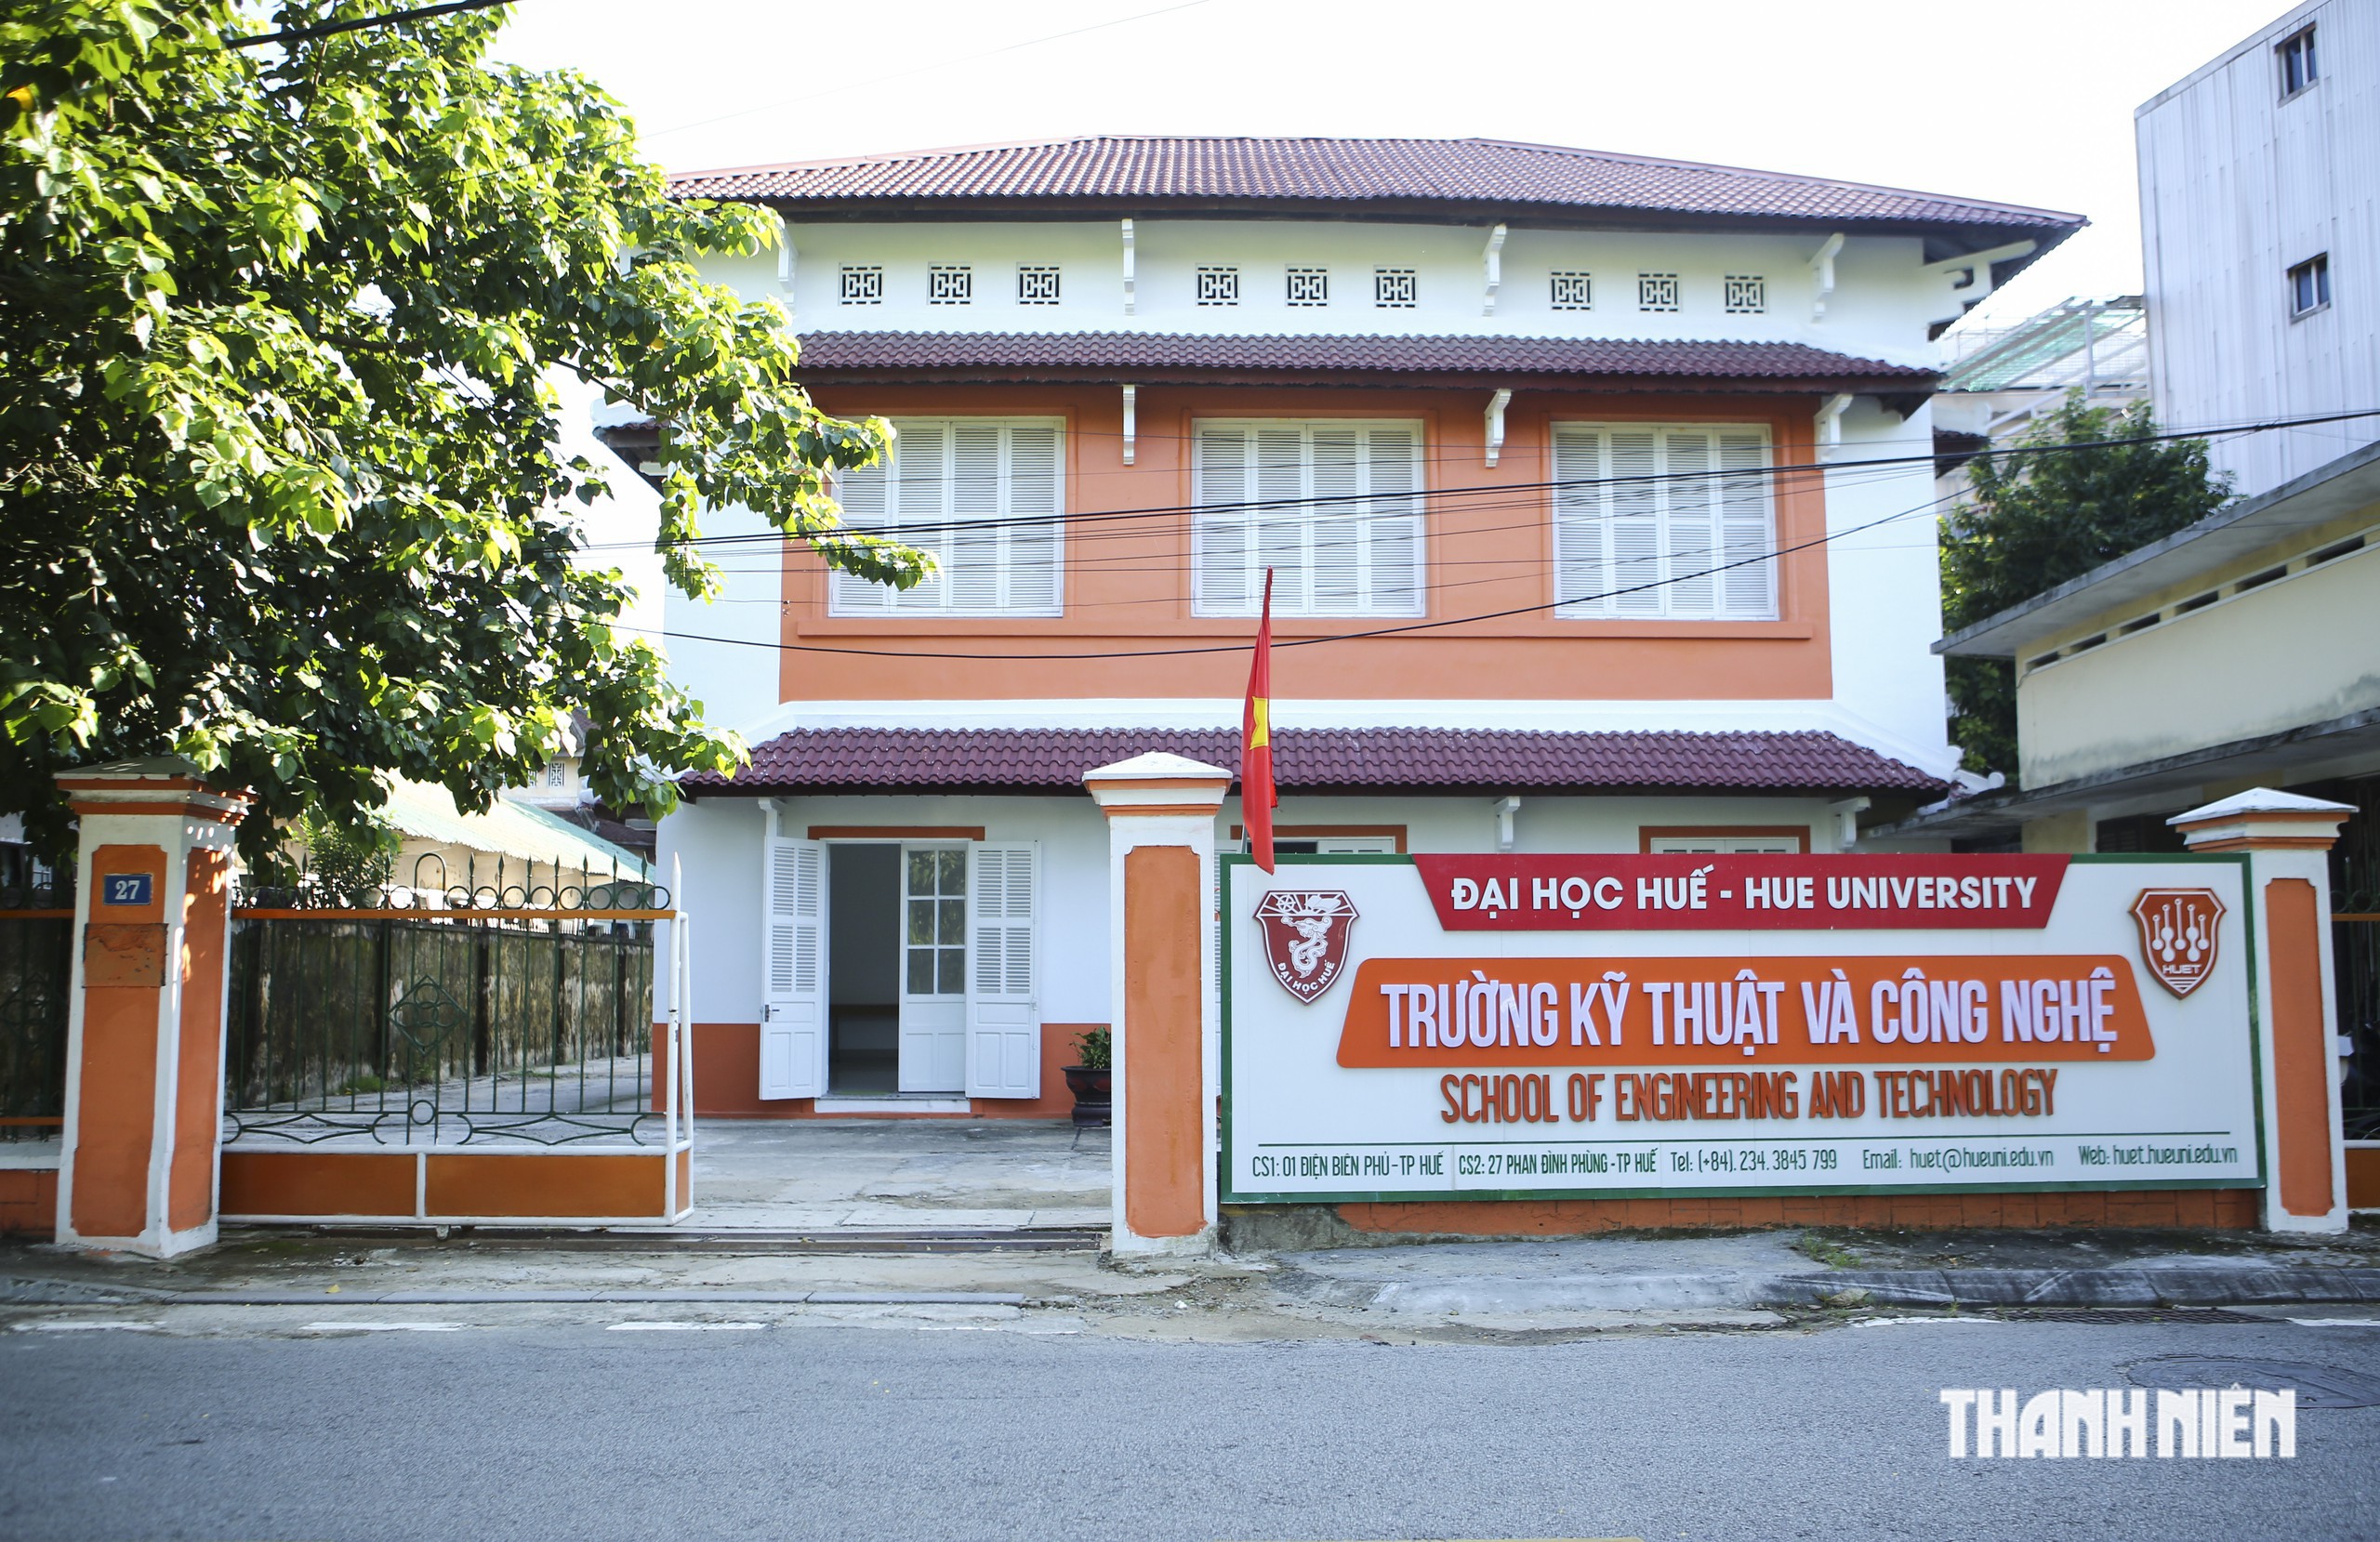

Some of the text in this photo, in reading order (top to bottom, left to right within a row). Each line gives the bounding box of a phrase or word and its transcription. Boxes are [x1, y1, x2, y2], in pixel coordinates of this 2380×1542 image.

[114, 880, 140, 900] 27
[1451, 864, 2037, 919] ĐẠI HỌC HUẾ - HUE UNIVERSITY
[1277, 959, 1336, 995] ĐẠI HỌC HUẾ
[2162, 964, 2202, 974] HUET
[1381, 967, 2118, 1057] TRƯỜNG KỸ THUẬT VÀ CÔNG NGHỆ
[1440, 1069, 2058, 1123] SCHOOL OF ENGINEERING AND TECHNOLOGY
[1252, 1156, 1280, 1177] CS1:
[1283, 1156, 1296, 1177] 01
[1301, 1153, 1328, 1180] ĐIỆN
[1332, 1153, 1359, 1176] BIÊN
[1420, 1151, 1444, 1176] HUẾ
[1459, 1154, 1485, 1175] CS2:
[1488, 1154, 1502, 1175] 27
[1506, 1154, 1537, 1175] PHAN
[1541, 1150, 1567, 1174] ĐÌNH
[1571, 1150, 1608, 1173] PHÙNG
[1634, 1148, 1659, 1172] HUẾ
[1671, 1152, 1693, 1172] Tel:
[1772, 1150, 1806, 1170] 3845
[1813, 1149, 1837, 1170] 799
[1863, 1147, 2054, 1173] Email: huet@hueuni.edu.vn
[2078, 1143, 2238, 1166] Web: huet.hueuni.edu.vn
